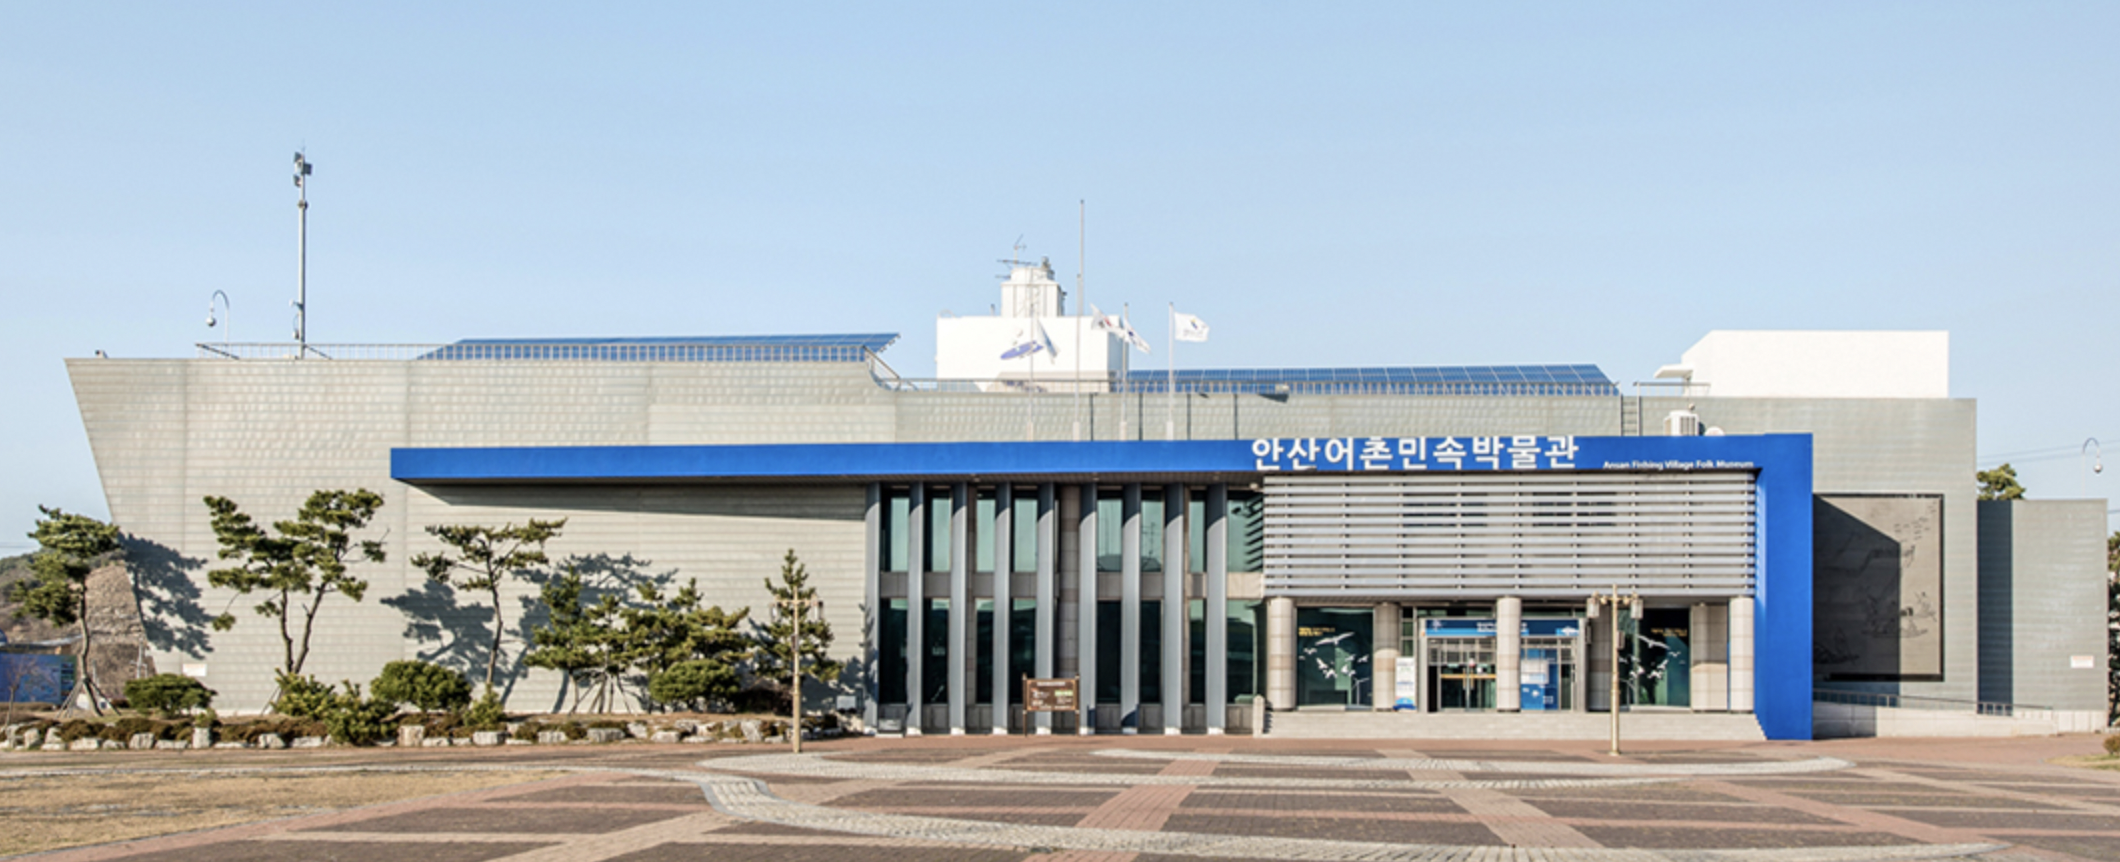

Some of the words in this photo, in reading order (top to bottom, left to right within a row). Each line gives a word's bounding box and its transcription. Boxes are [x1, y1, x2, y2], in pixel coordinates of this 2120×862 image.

[1251, 435, 1579, 471] 안산어촌민속박물관
[1603, 461, 1629, 469] Ansan
[1632, 460, 1663, 470] Fishing
[1665, 460, 1694, 470] Village
[1696, 460, 1714, 469] Folk
[1716, 460, 1754, 469] Museum
